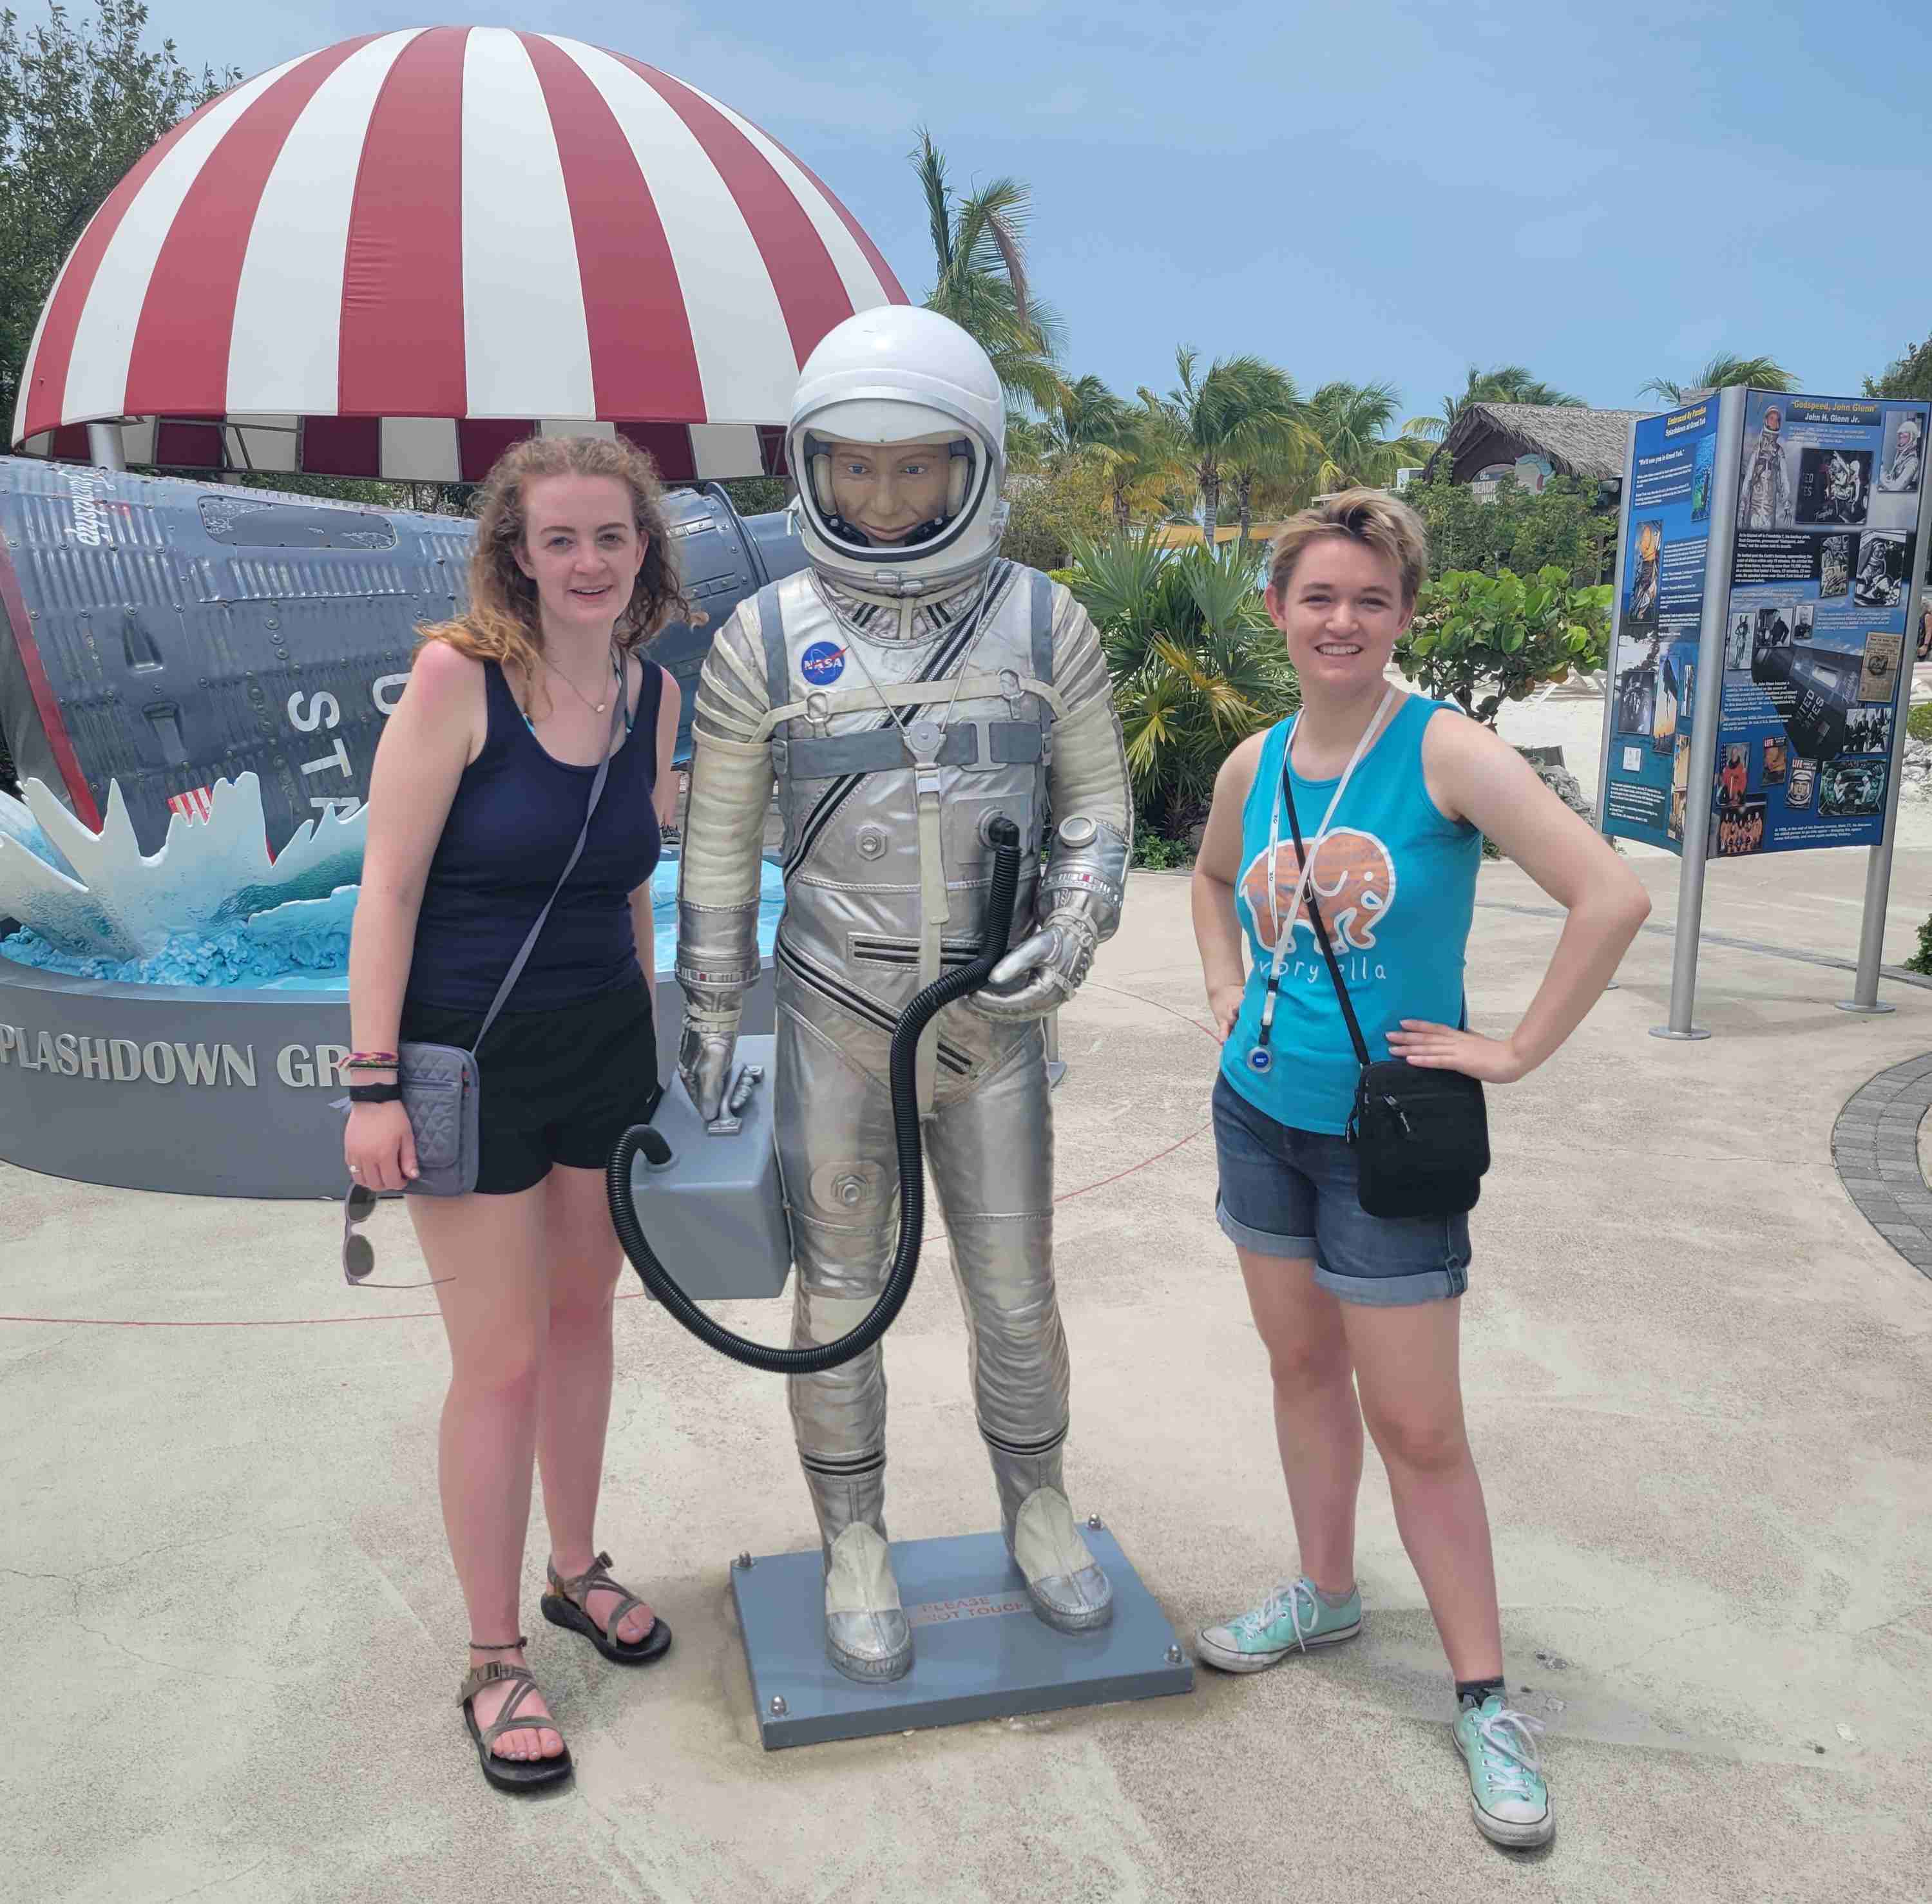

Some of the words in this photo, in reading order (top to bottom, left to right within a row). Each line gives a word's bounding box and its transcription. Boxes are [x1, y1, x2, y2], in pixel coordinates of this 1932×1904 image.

[1833, 402, 1851, 412] John
[1804, 413, 1821, 421] John
[1830, 414, 1850, 423] Glenn
[1851, 415, 1860, 423] Jr.
[803, 657, 843, 671] NASA
[1764, 738, 1774, 748] LIFE
[1792, 758, 1803, 768] LIFE
[1253, 953, 1319, 984] vory
[0, 1023, 257, 1087] PLASHDOWN
